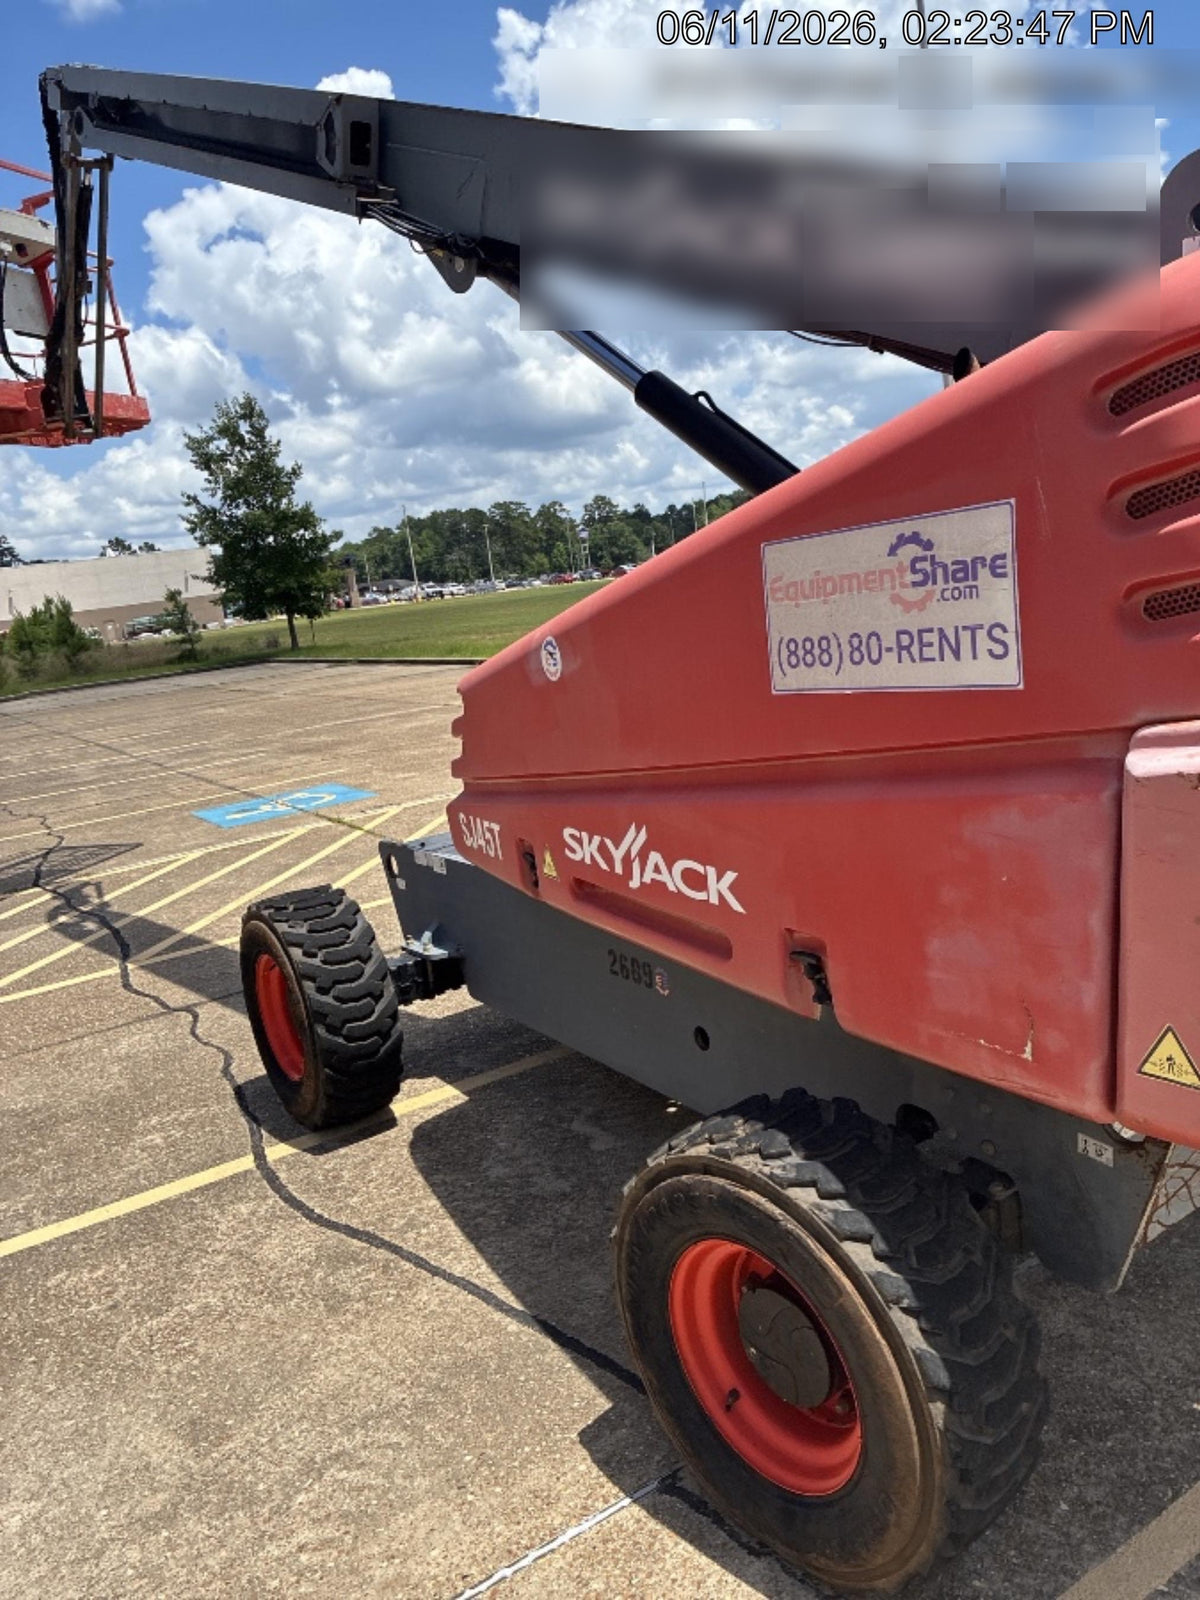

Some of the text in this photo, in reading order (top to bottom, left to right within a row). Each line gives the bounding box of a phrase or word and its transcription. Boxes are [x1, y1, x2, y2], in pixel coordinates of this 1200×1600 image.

[935, 584, 979, 602] .com
[459, 812, 504, 861] SJ45T
[562, 822, 747, 915] SKYJACK
